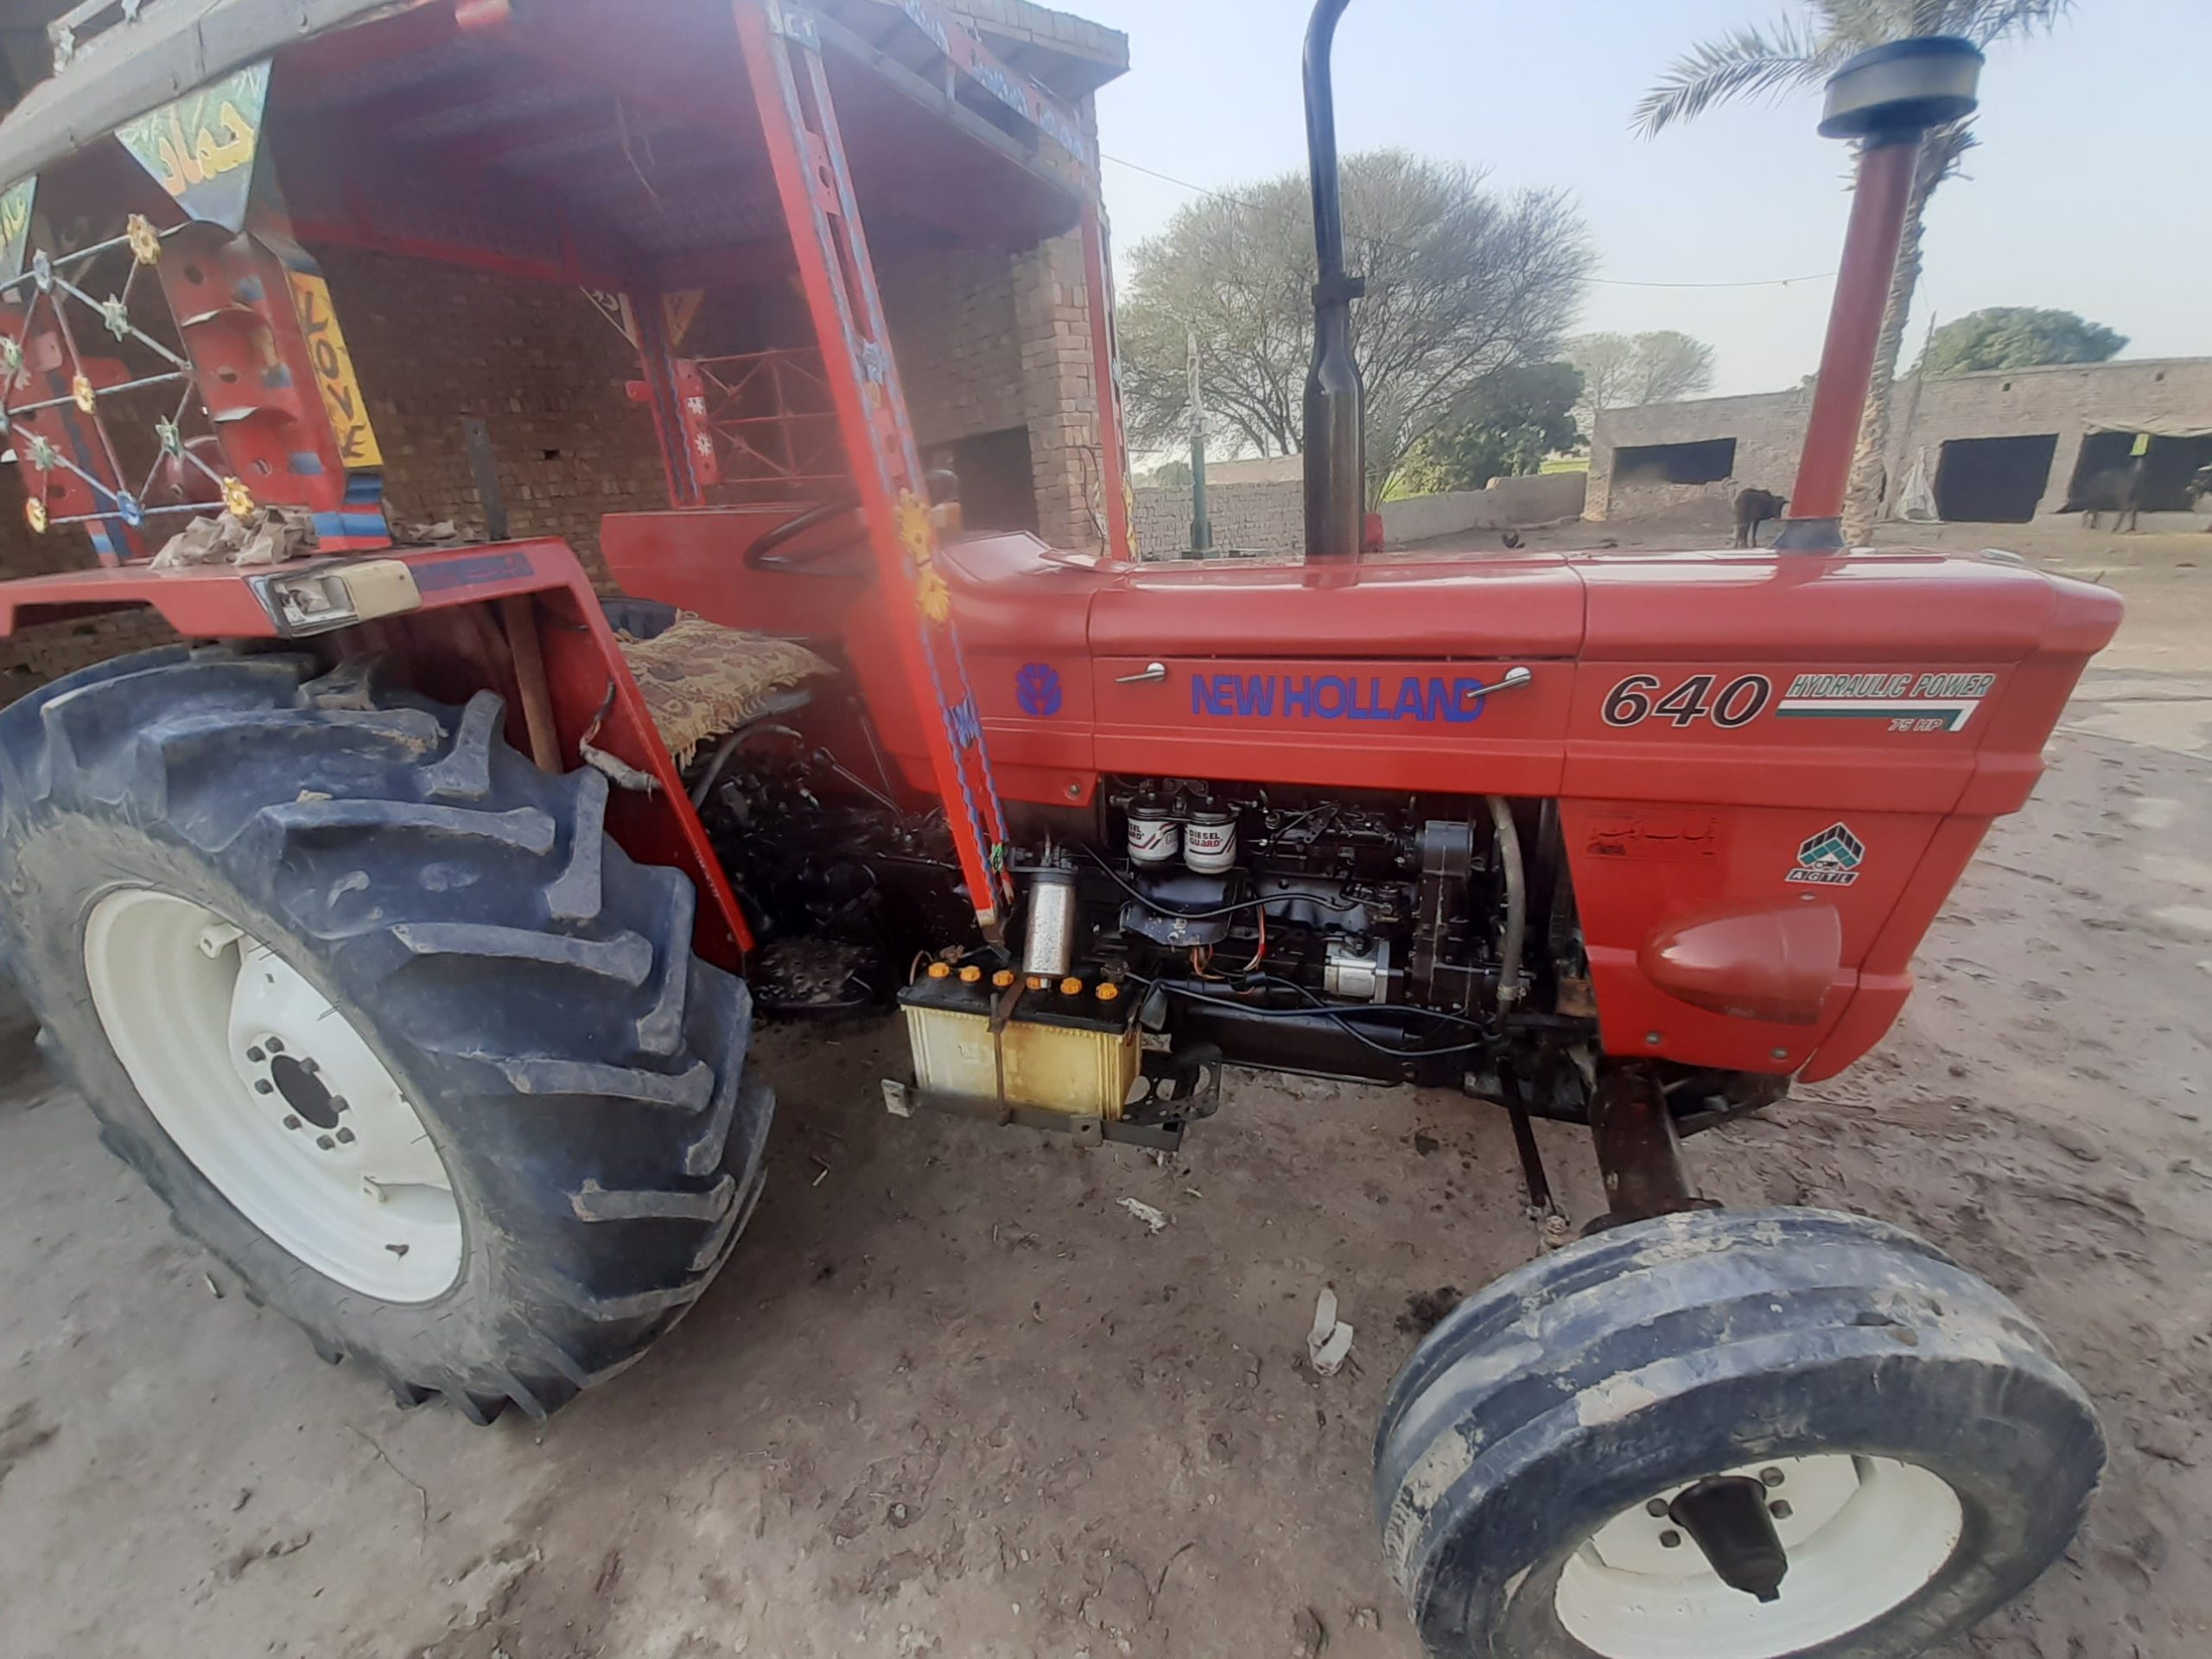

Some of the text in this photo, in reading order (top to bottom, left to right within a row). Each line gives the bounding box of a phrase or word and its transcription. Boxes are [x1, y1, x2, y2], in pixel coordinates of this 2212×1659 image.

[302, 291, 366, 459] LOVE
[1786, 672, 1997, 697] HYDRAULIC POWER
[1192, 674, 1486, 722] NEW HOLLAND
[1601, 673, 1771, 728] 640
[1887, 718, 1943, 732] 75 HP
[1189, 830, 1220, 839] DIESEL
[1792, 871, 1849, 883] AGTL
